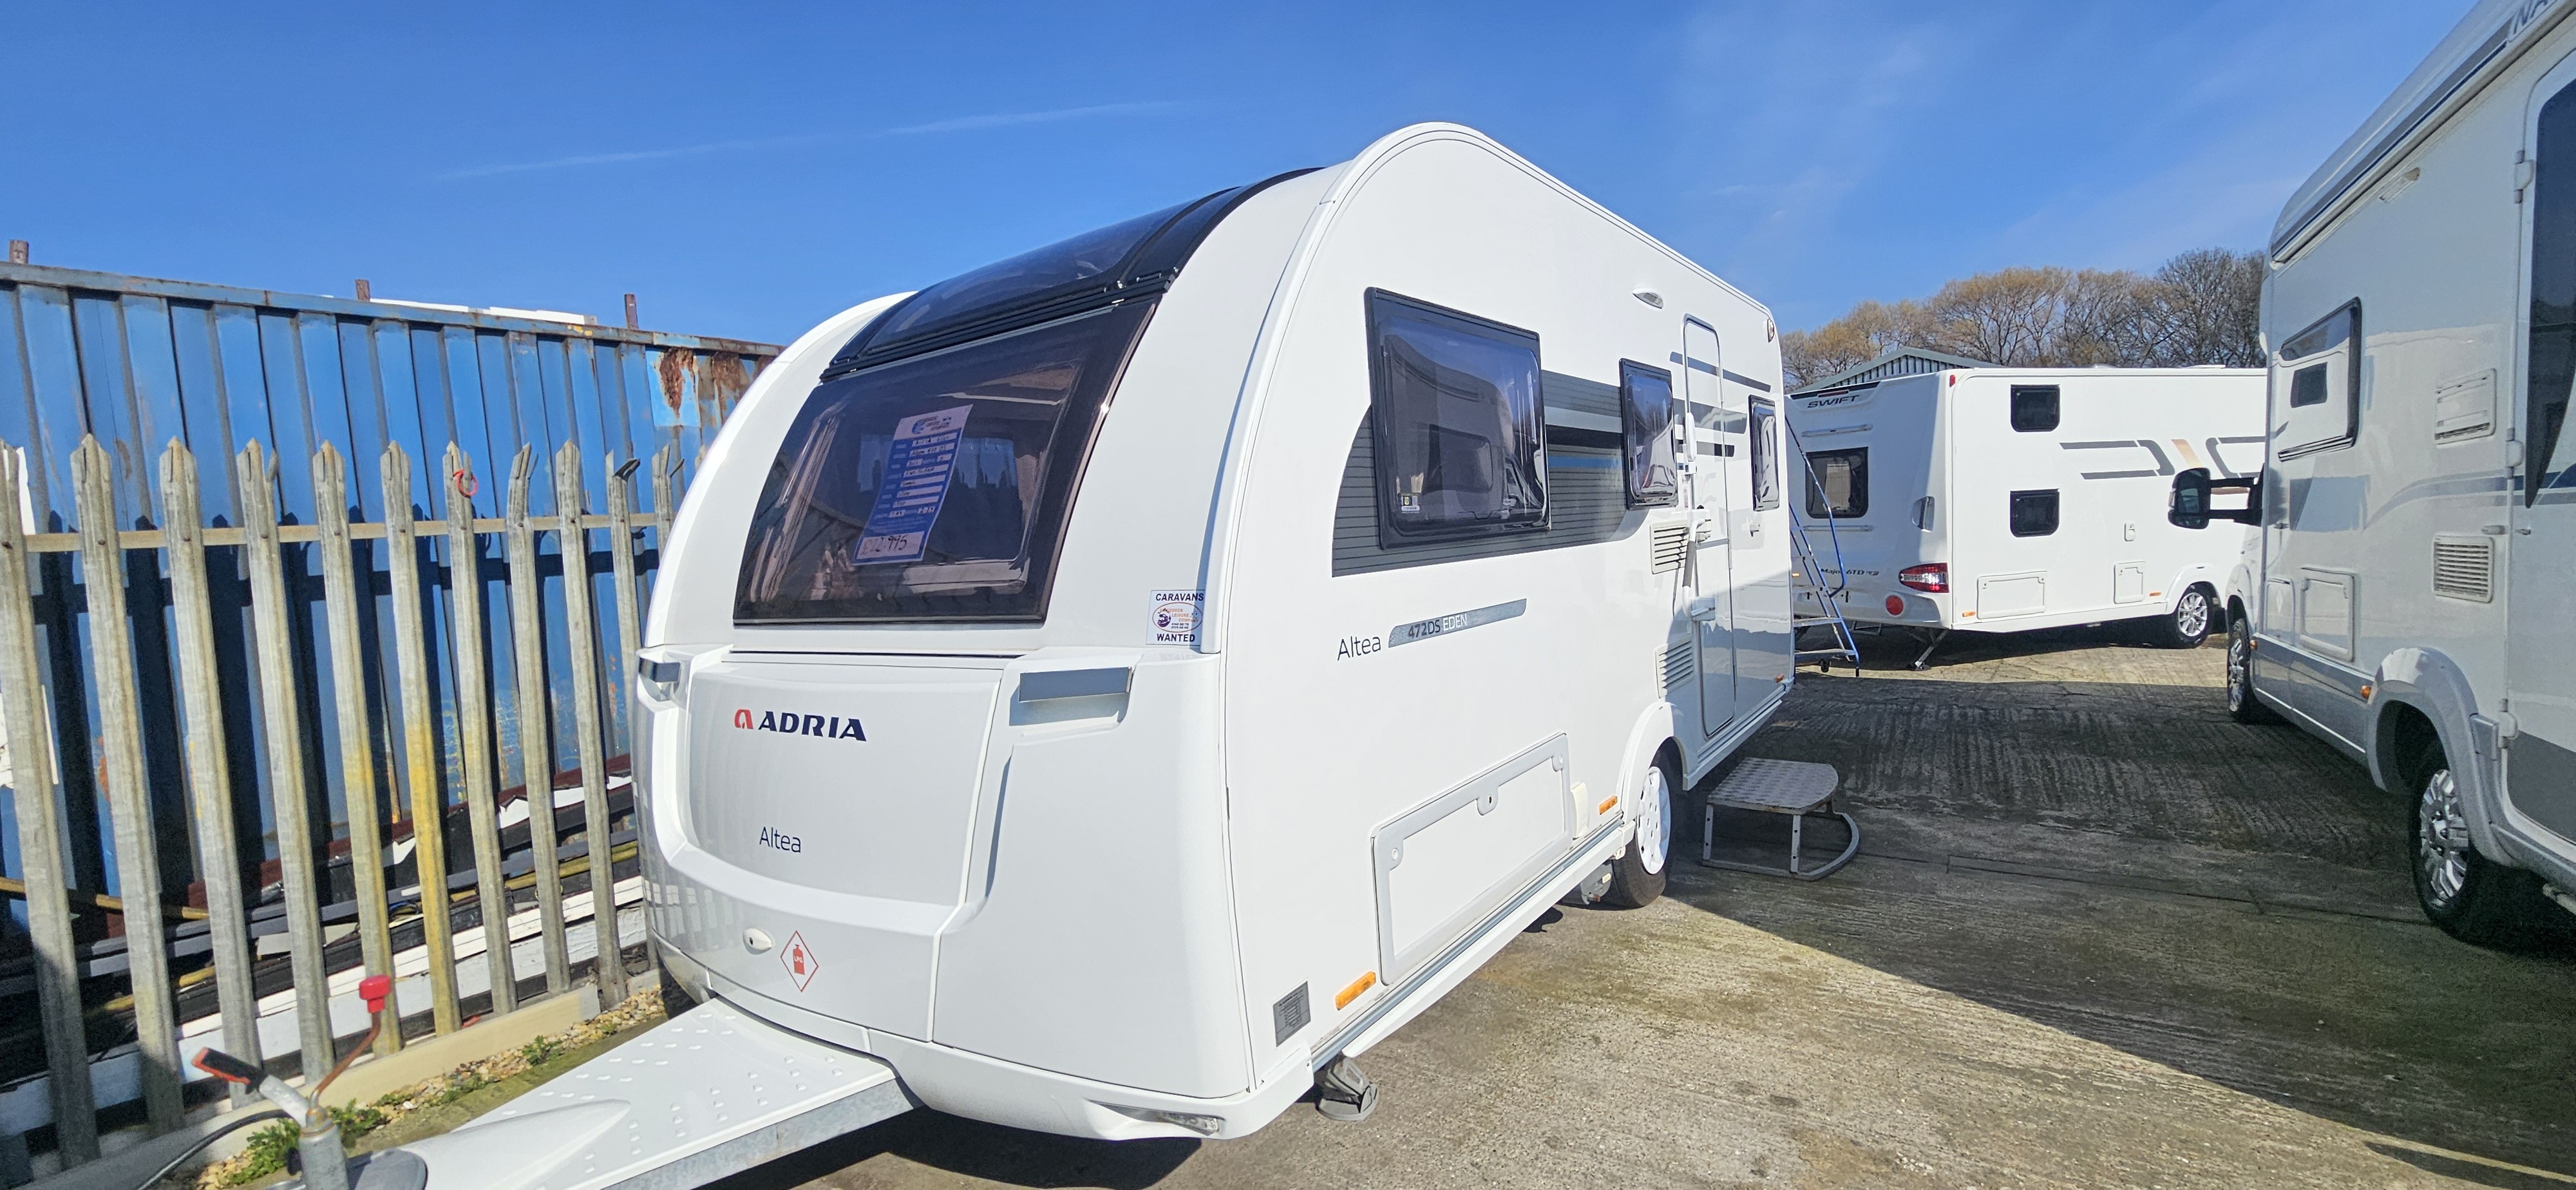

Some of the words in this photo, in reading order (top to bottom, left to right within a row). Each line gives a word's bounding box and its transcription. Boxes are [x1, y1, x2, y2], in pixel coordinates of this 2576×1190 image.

[1807, 395, 1860, 408] SWIFT
[1155, 592, 1204, 601] CARAVANS
[1157, 633, 1195, 643] WANTED
[1337, 636, 1381, 661] Altea
[1408, 619, 1441, 639] 472DS
[1443, 613, 1467, 632] EDEN
[757, 710, 867, 742] ADRIA
[759, 826, 800, 853] Altea
